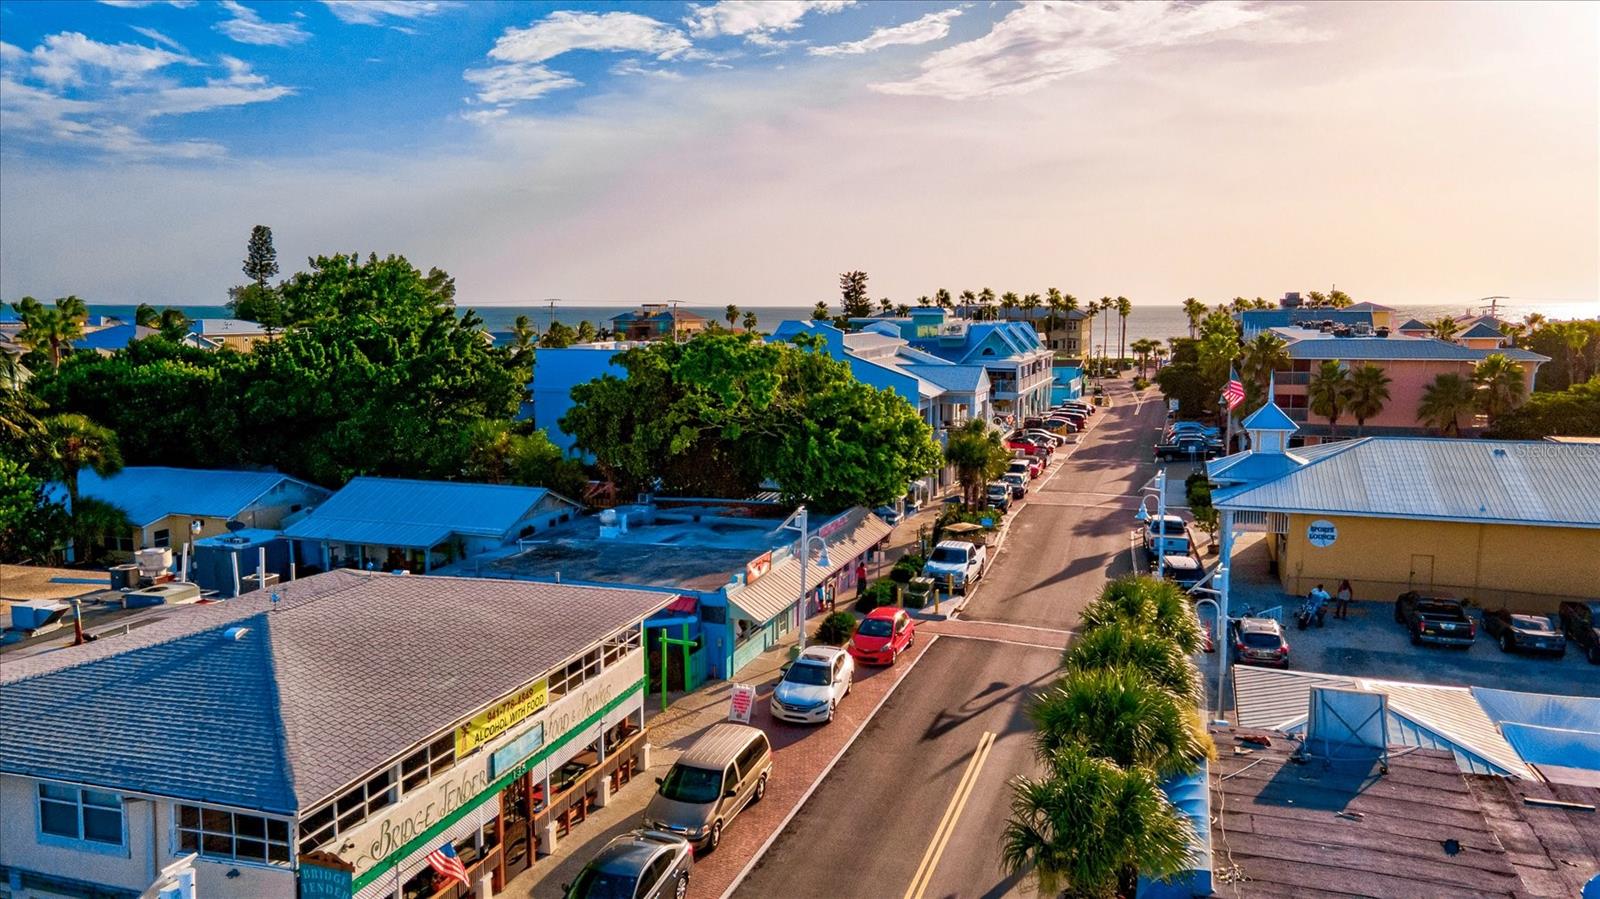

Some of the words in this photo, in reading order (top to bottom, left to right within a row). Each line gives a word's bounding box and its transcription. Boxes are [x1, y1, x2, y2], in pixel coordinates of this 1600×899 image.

[474, 718, 508, 745] ALCOHOL
[510, 706, 526, 724] WITH
[527, 694, 544, 713] FOOD
[370, 802, 435, 861] BRIDGE
[440, 770, 488, 817] TENDER
[303, 869, 346, 886] BRIDGE
